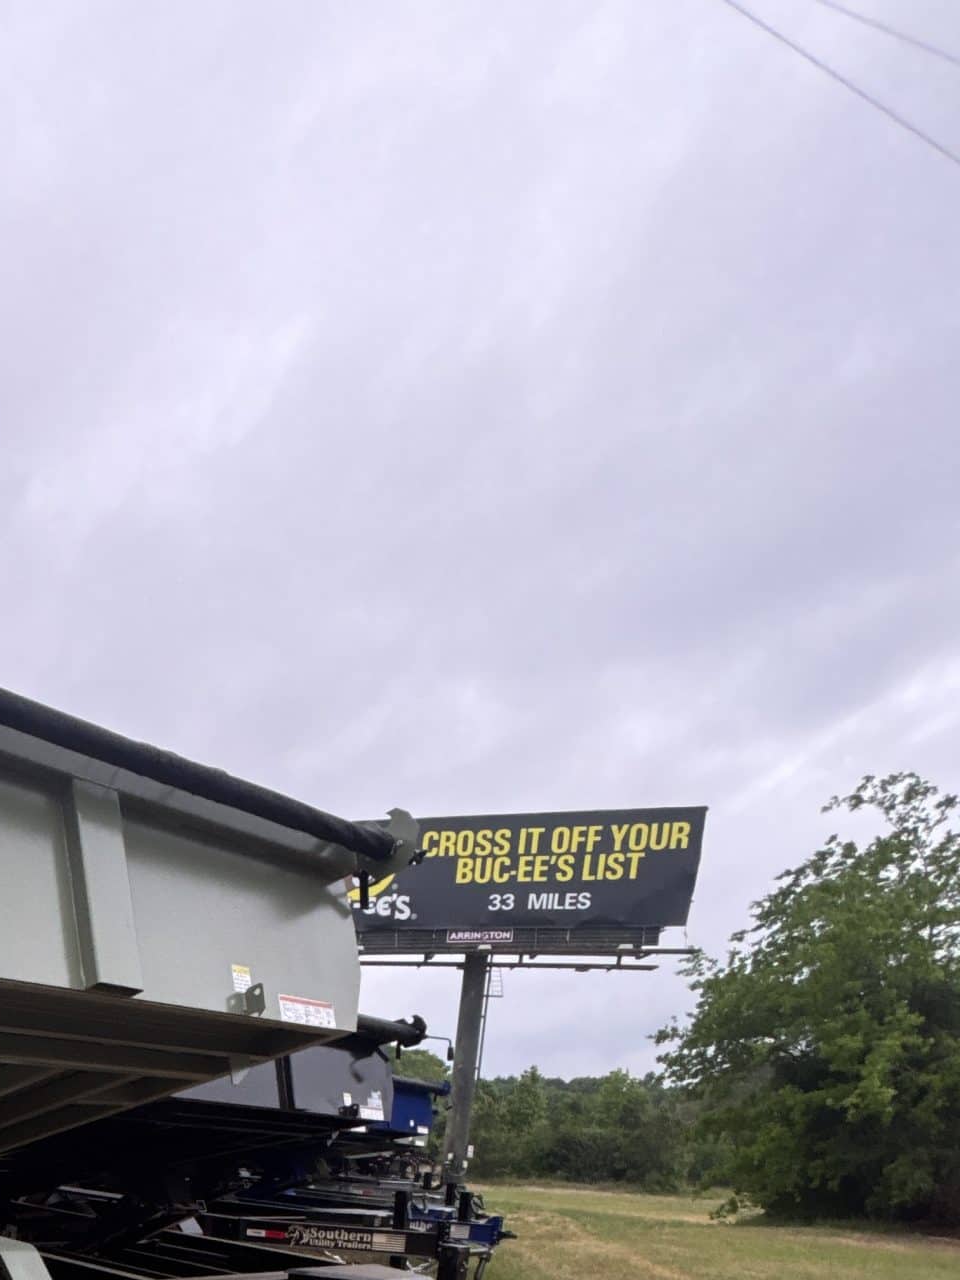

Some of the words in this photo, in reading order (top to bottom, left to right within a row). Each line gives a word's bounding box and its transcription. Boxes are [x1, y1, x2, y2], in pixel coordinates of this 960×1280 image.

[422, 828, 511, 857] CROSS
[518, 827, 545, 854] IT
[551, 825, 603, 854] OFF
[611, 822, 690, 851] YOUR
[455, 854, 575, 884] BUC-EE'S
[582, 852, 645, 881] LIST
[488, 893, 515, 911] 33
[527, 892, 592, 910] MILES
[449, 931, 511, 940] ARRINGTON
[309, 1227, 372, 1241] Southern
[309, 1237, 335, 1248] Utility
[337, 1239, 372, 1250] Trailers
